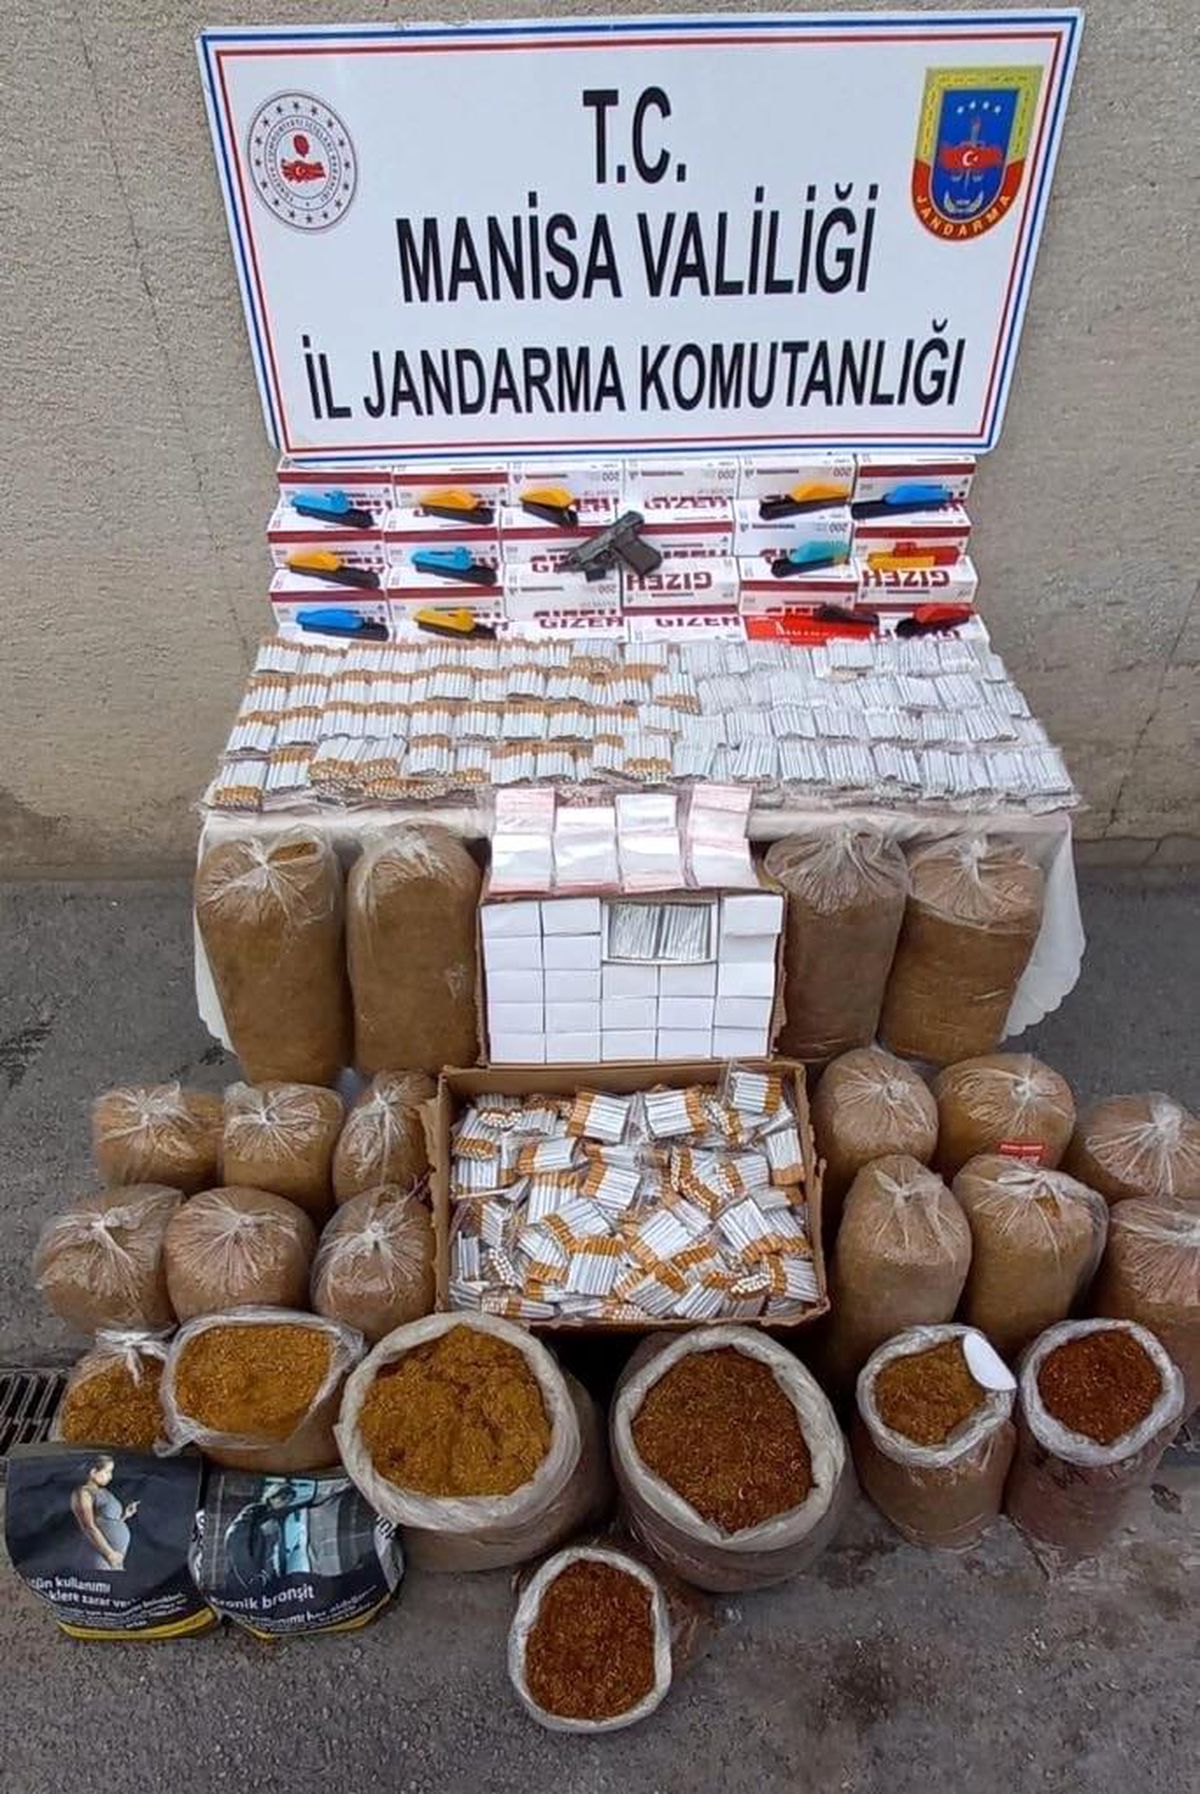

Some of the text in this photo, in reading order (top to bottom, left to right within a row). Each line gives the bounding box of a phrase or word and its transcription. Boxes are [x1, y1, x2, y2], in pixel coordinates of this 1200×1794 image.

[582, 86, 687, 184] T.C.
[916, 195, 1011, 237] JANDARMA
[396, 182, 879, 303] MANİSA VALİLİĞİ
[302, 319, 966, 419] İL JANDARMA KOMUTANLIĞI
[626, 571, 713, 591] GIZEH
[861, 569, 951, 588] GIZEH
[262, 1583, 315, 1609] bronşit
